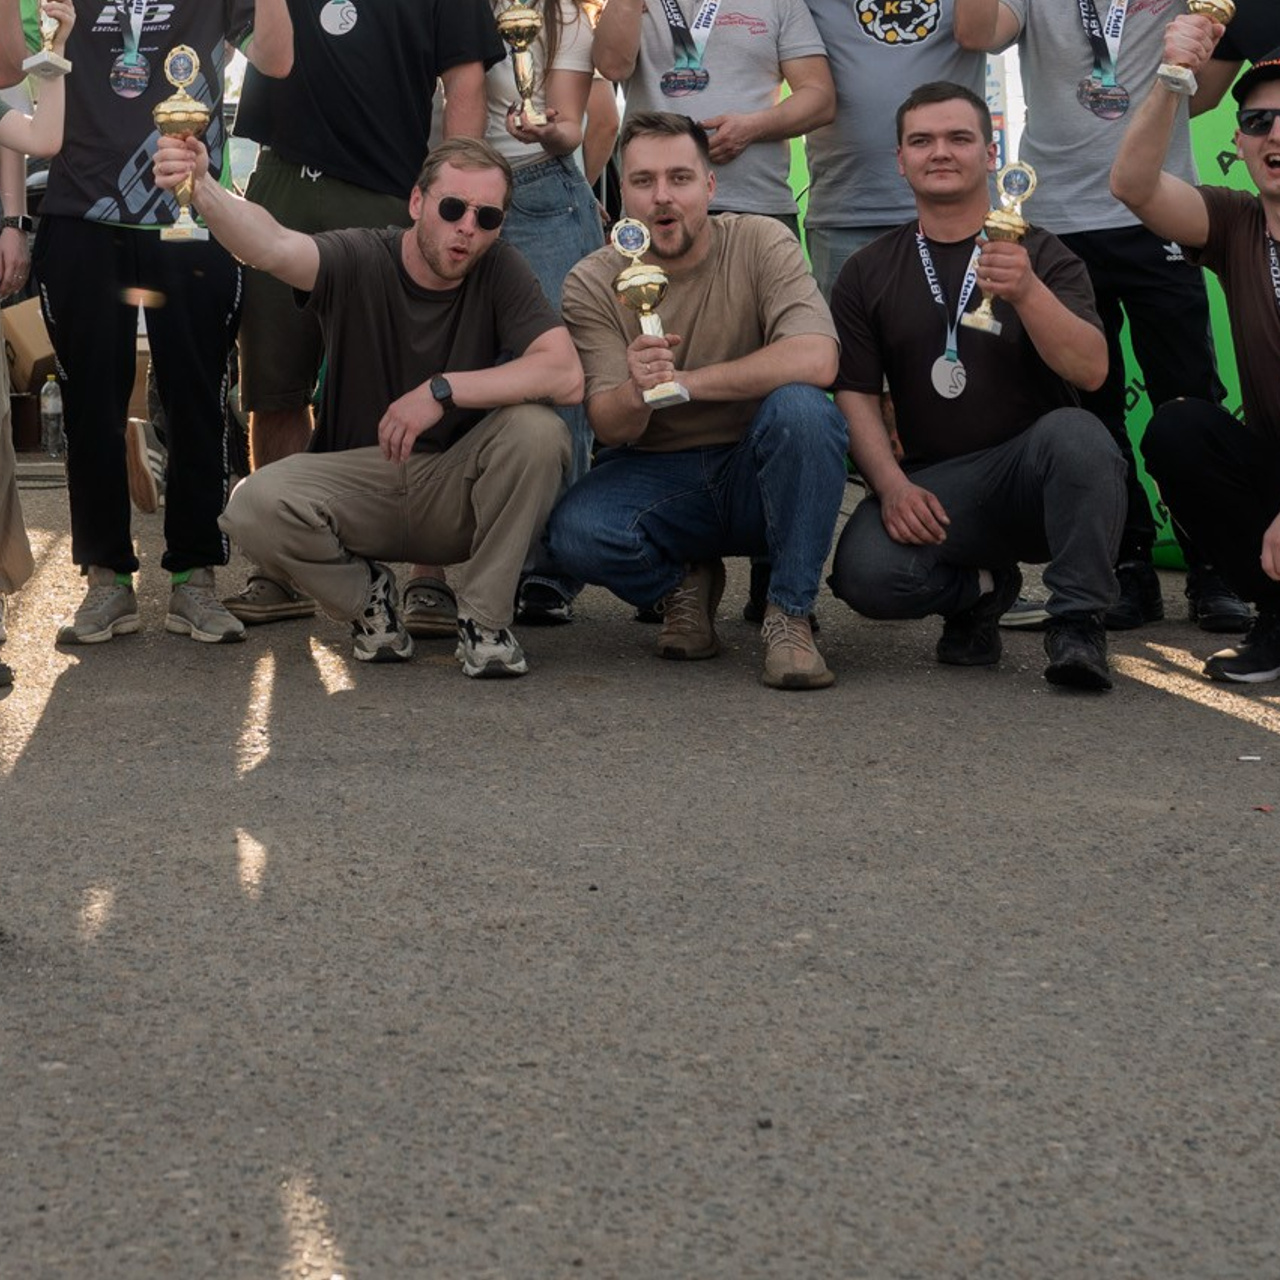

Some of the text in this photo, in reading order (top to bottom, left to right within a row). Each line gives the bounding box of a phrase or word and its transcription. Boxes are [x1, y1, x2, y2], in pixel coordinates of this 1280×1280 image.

[702, 1, 718, 29] ПРИЗ
[884, 0, 914, 15] KS
[1111, 7, 1125, 38] ПРИЗ
[915, 232, 945, 306] АВТОЗВУК
